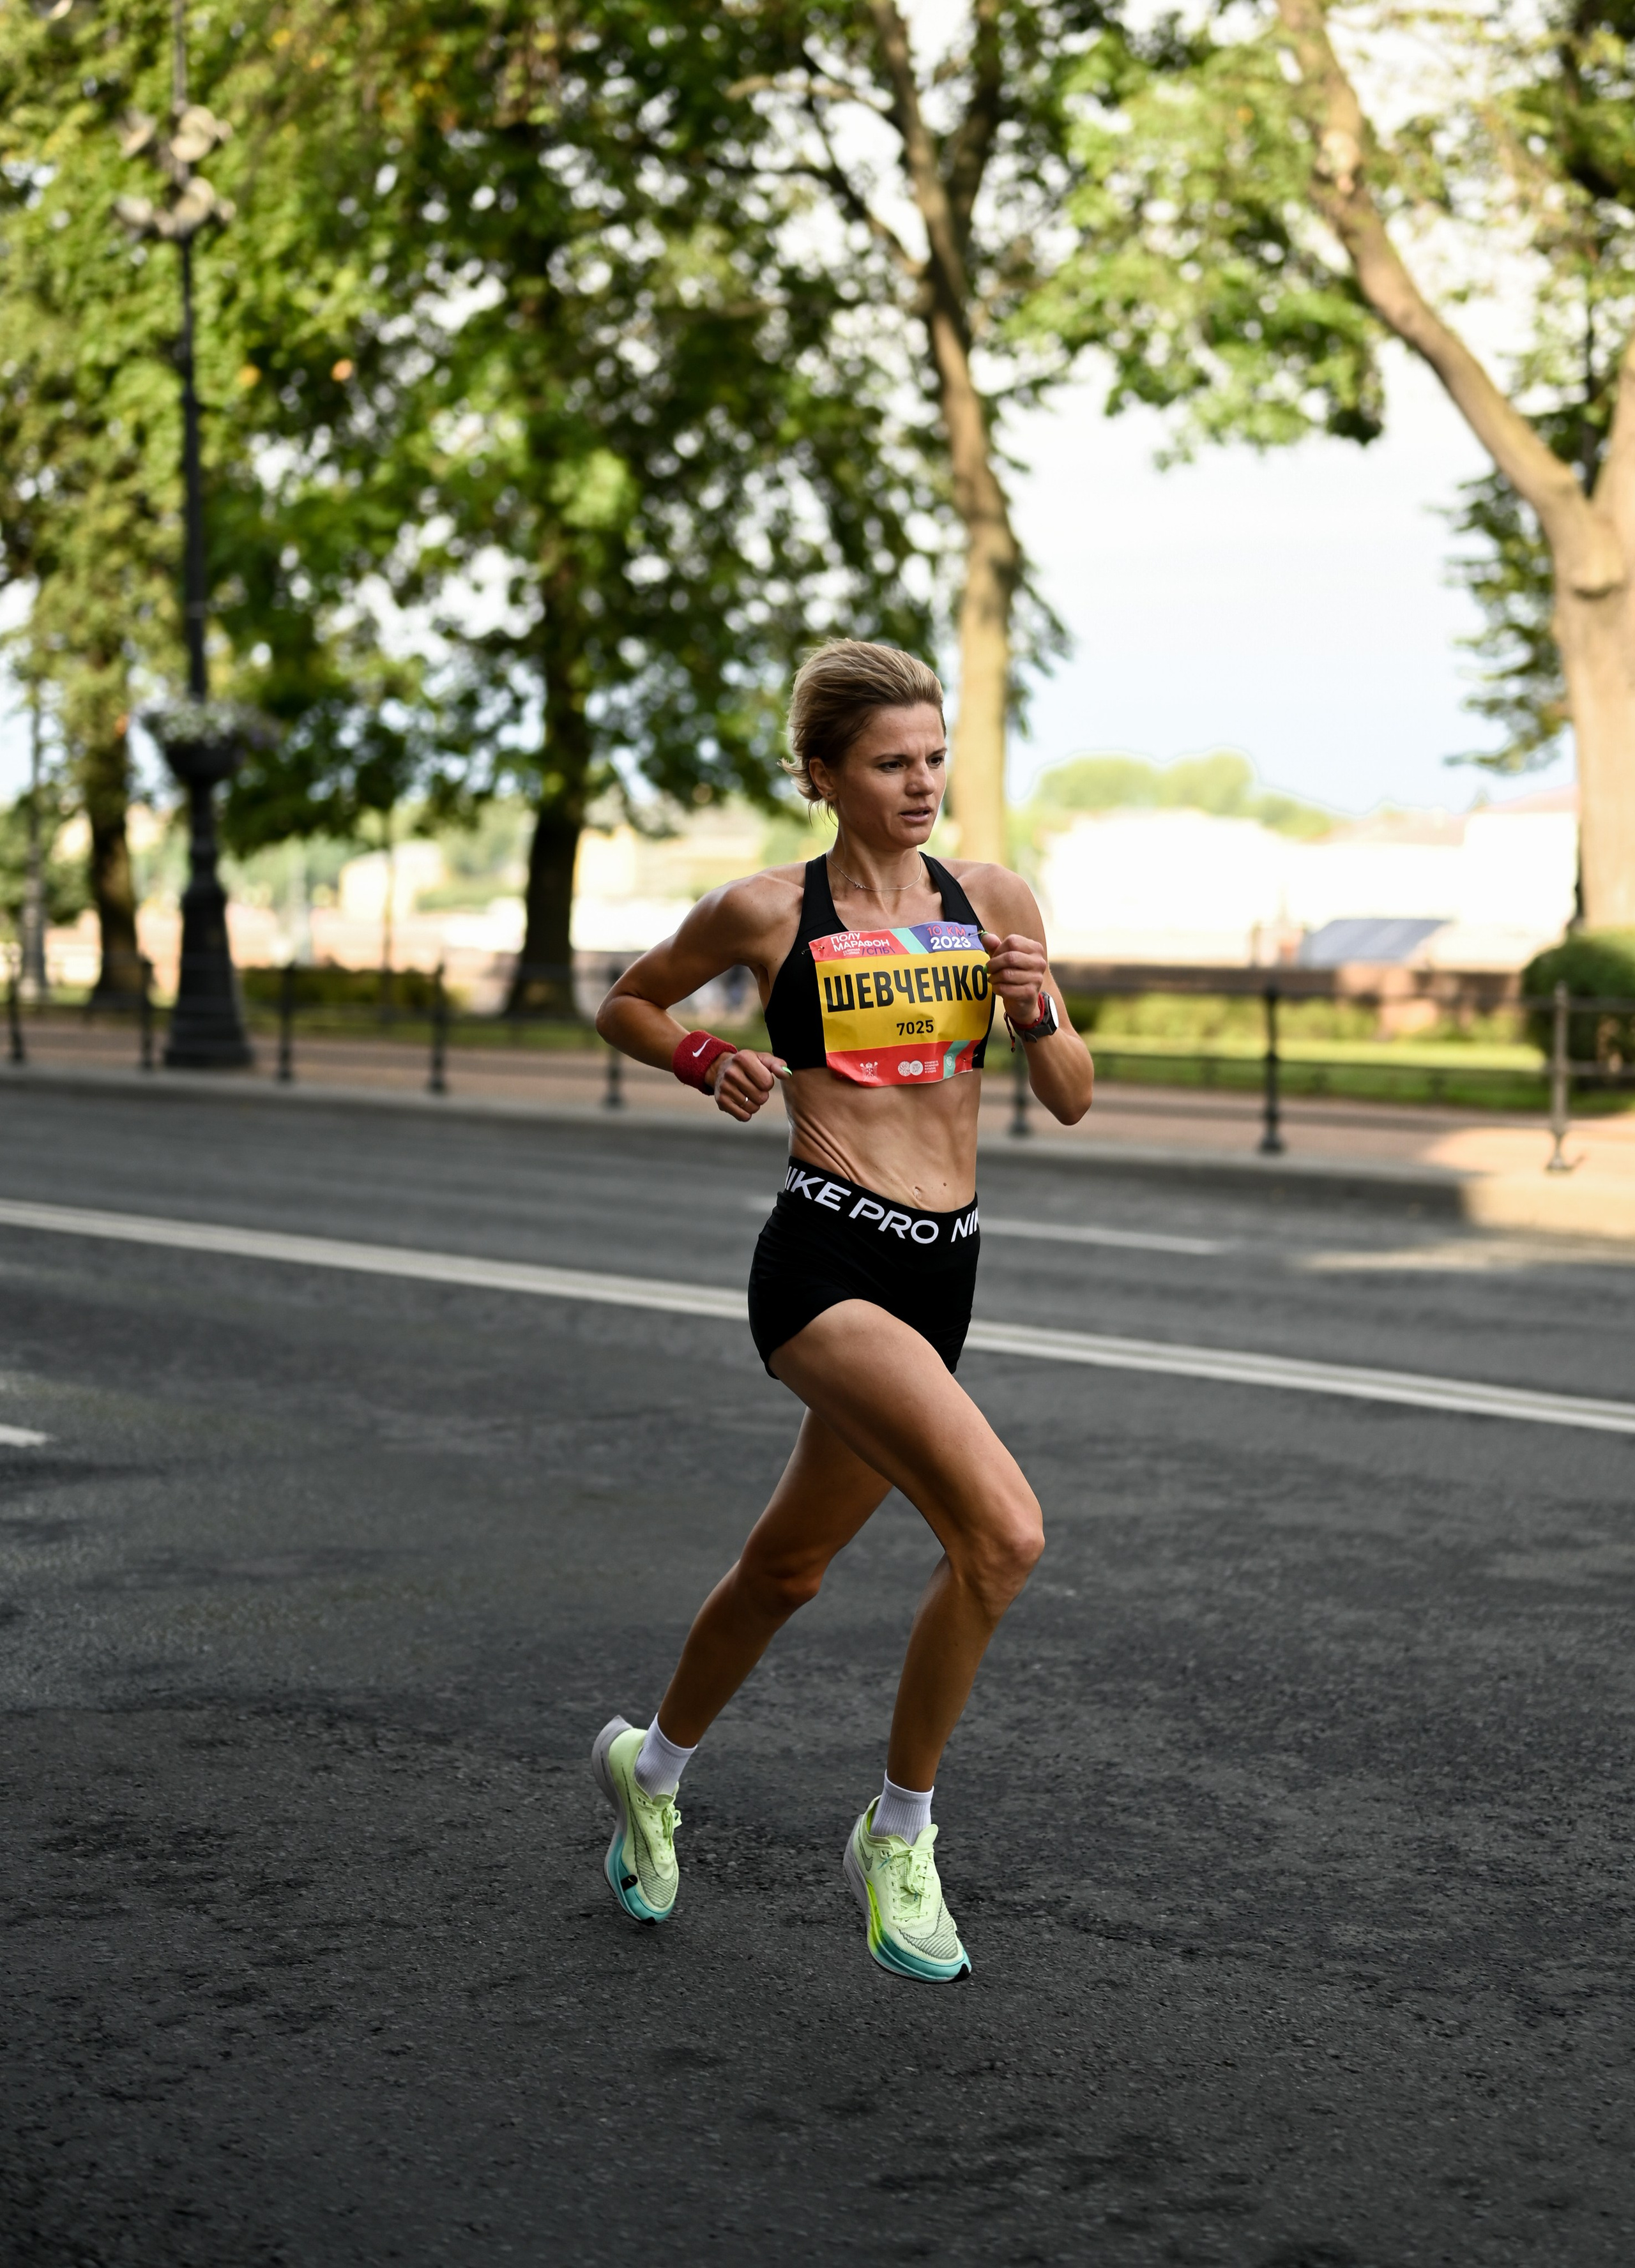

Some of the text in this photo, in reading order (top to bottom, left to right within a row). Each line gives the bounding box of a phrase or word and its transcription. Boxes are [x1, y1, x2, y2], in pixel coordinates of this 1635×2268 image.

[830, 933, 860, 944] ПОЛУ
[927, 925, 966, 937] 10 КМ
[833, 939, 890, 952] МАРАФОН
[930, 935, 971, 950] 2023
[824, 964, 988, 1013] ШЕВЧЕНКО
[897, 1020, 934, 1036] 7025
[848, 1197, 939, 1244] PRO
